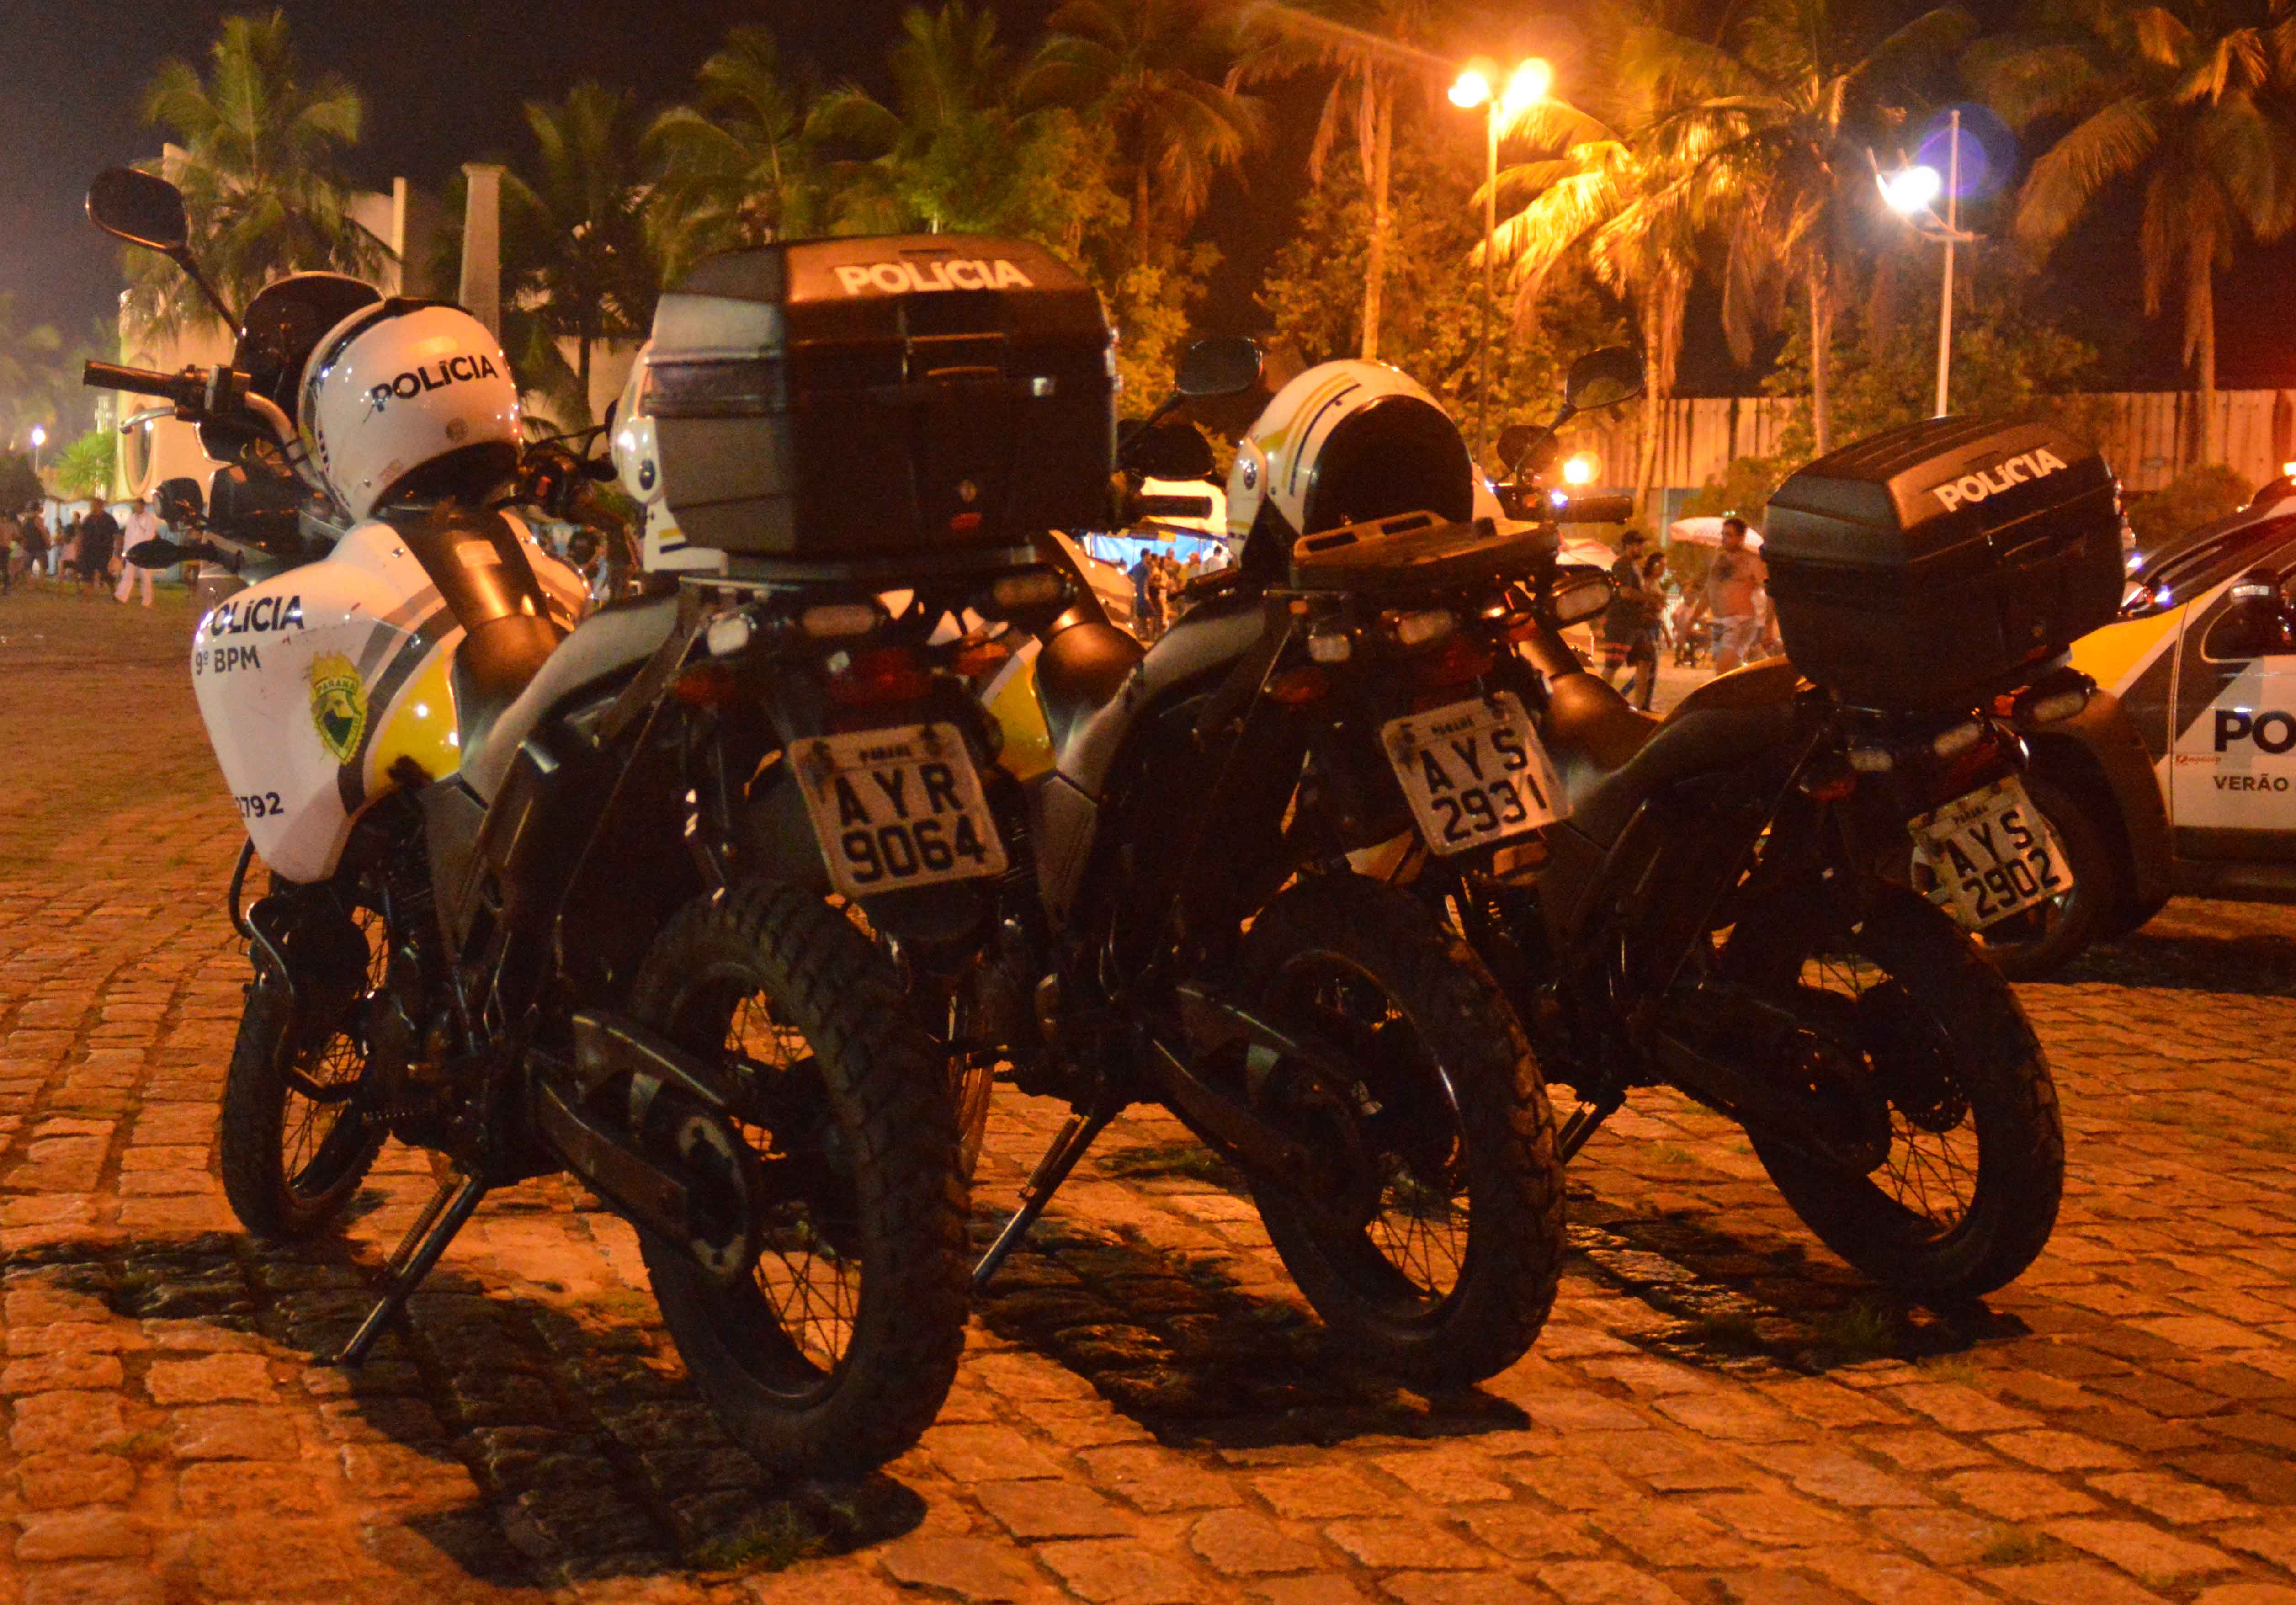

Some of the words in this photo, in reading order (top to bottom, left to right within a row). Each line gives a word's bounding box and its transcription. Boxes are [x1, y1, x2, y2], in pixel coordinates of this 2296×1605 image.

[834, 260, 1034, 295] POLÍCIA
[371, 355, 499, 412] POLÍCIA
[1933, 448, 2068, 512] POLÍCIA
[210, 595, 304, 636] OLÍCIA
[214, 645, 261, 673] BPM
[1419, 728, 1528, 793] AYS
[2213, 773, 2289, 792] VERÃO
[836, 763, 965, 826] AYR
[1431, 774, 1547, 842] 2931
[842, 814, 985, 884] 9064
[1946, 811, 2034, 878] AYS
[1962, 848, 2061, 919] 2902
